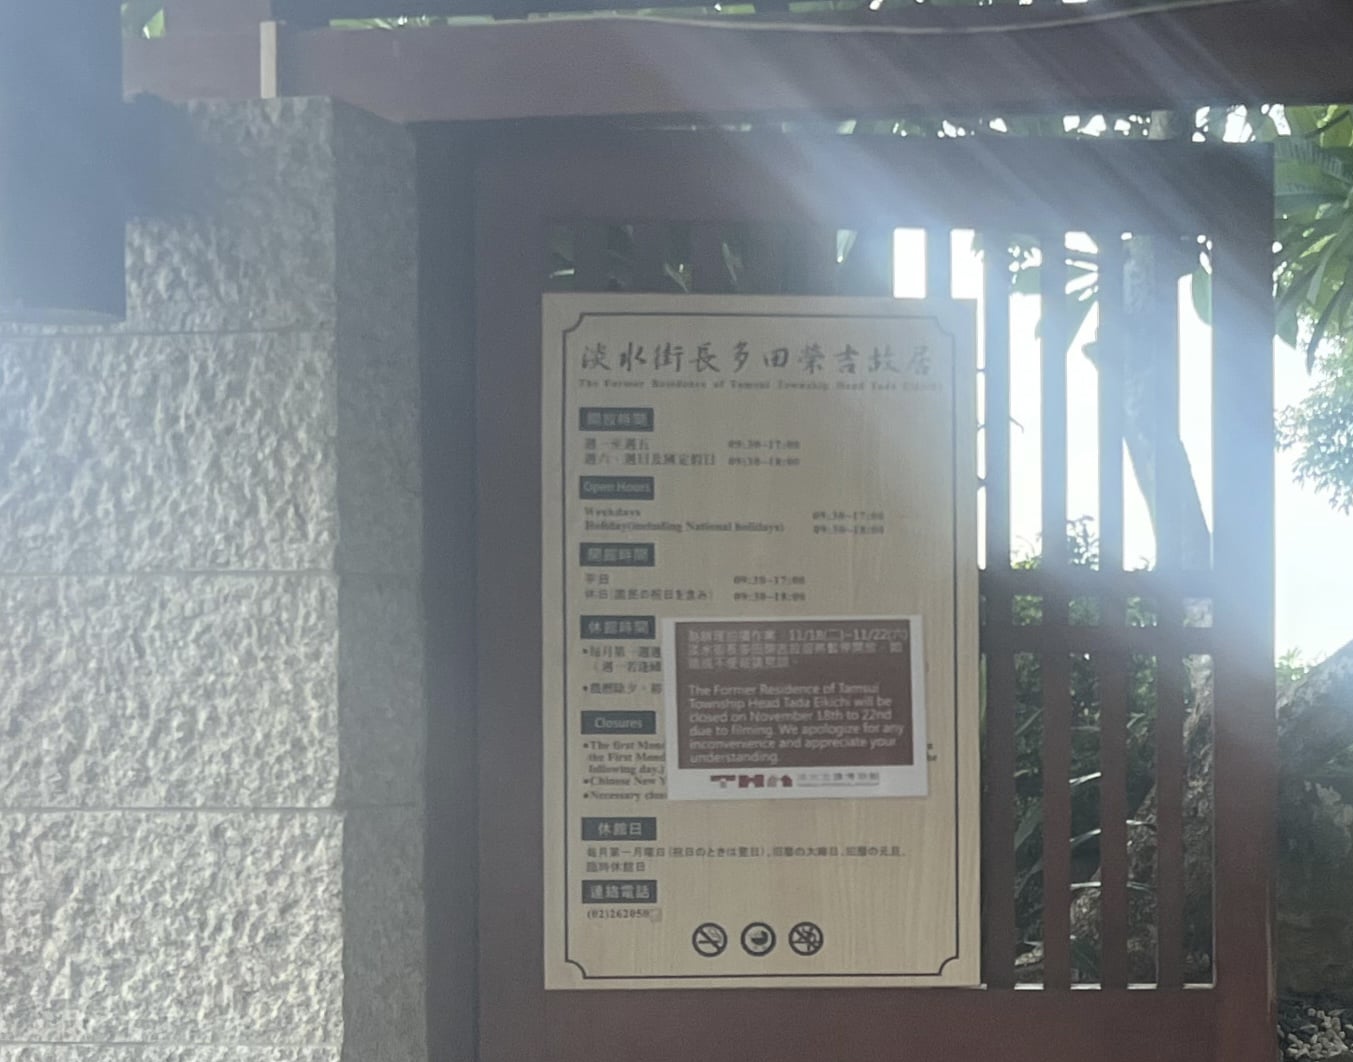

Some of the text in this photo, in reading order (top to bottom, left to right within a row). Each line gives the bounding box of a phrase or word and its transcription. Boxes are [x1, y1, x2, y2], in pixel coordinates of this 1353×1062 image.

[581, 341, 932, 376] 淡水街長多田榮吉故居
[583, 481, 652, 495] Open Hours
[584, 506, 641, 518] Weekdays
[686, 521, 732, 532] National
[584, 572, 609, 584] 平日
[689, 684, 711, 696] The
[714, 684, 757, 696] Former
[760, 682, 820, 695] Residence
[823, 682, 837, 694] of
[690, 697, 746, 711] Township
[748, 697, 780, 709] Head
[784, 696, 811, 708] Tada
[854, 695, 875, 707] will
[877, 695, 893, 707] be
[690, 709, 893, 724] closed on November 18th to 22nd
[594, 717, 644, 730] Closures
[690, 725, 713, 737] due
[716, 726, 729, 736] to
[779, 724, 799, 736] We
[802, 723, 861, 737] apologize
[863, 722, 880, 734] for
[882, 723, 904, 736] any
[590, 741, 610, 750] The
[613, 740, 635, 750] first
[690, 736, 897, 750] inconvenience and appreciate your
[588, 753, 606, 763] the
[608, 753, 633, 762] First
[588, 765, 638, 776] following
[590, 776, 632, 787] Chinese
[634, 776, 657, 787] New
[590, 790, 640, 802] Necessary
[597, 821, 643, 837] 休館日
[586, 860, 646, 873] 臨時休館日
